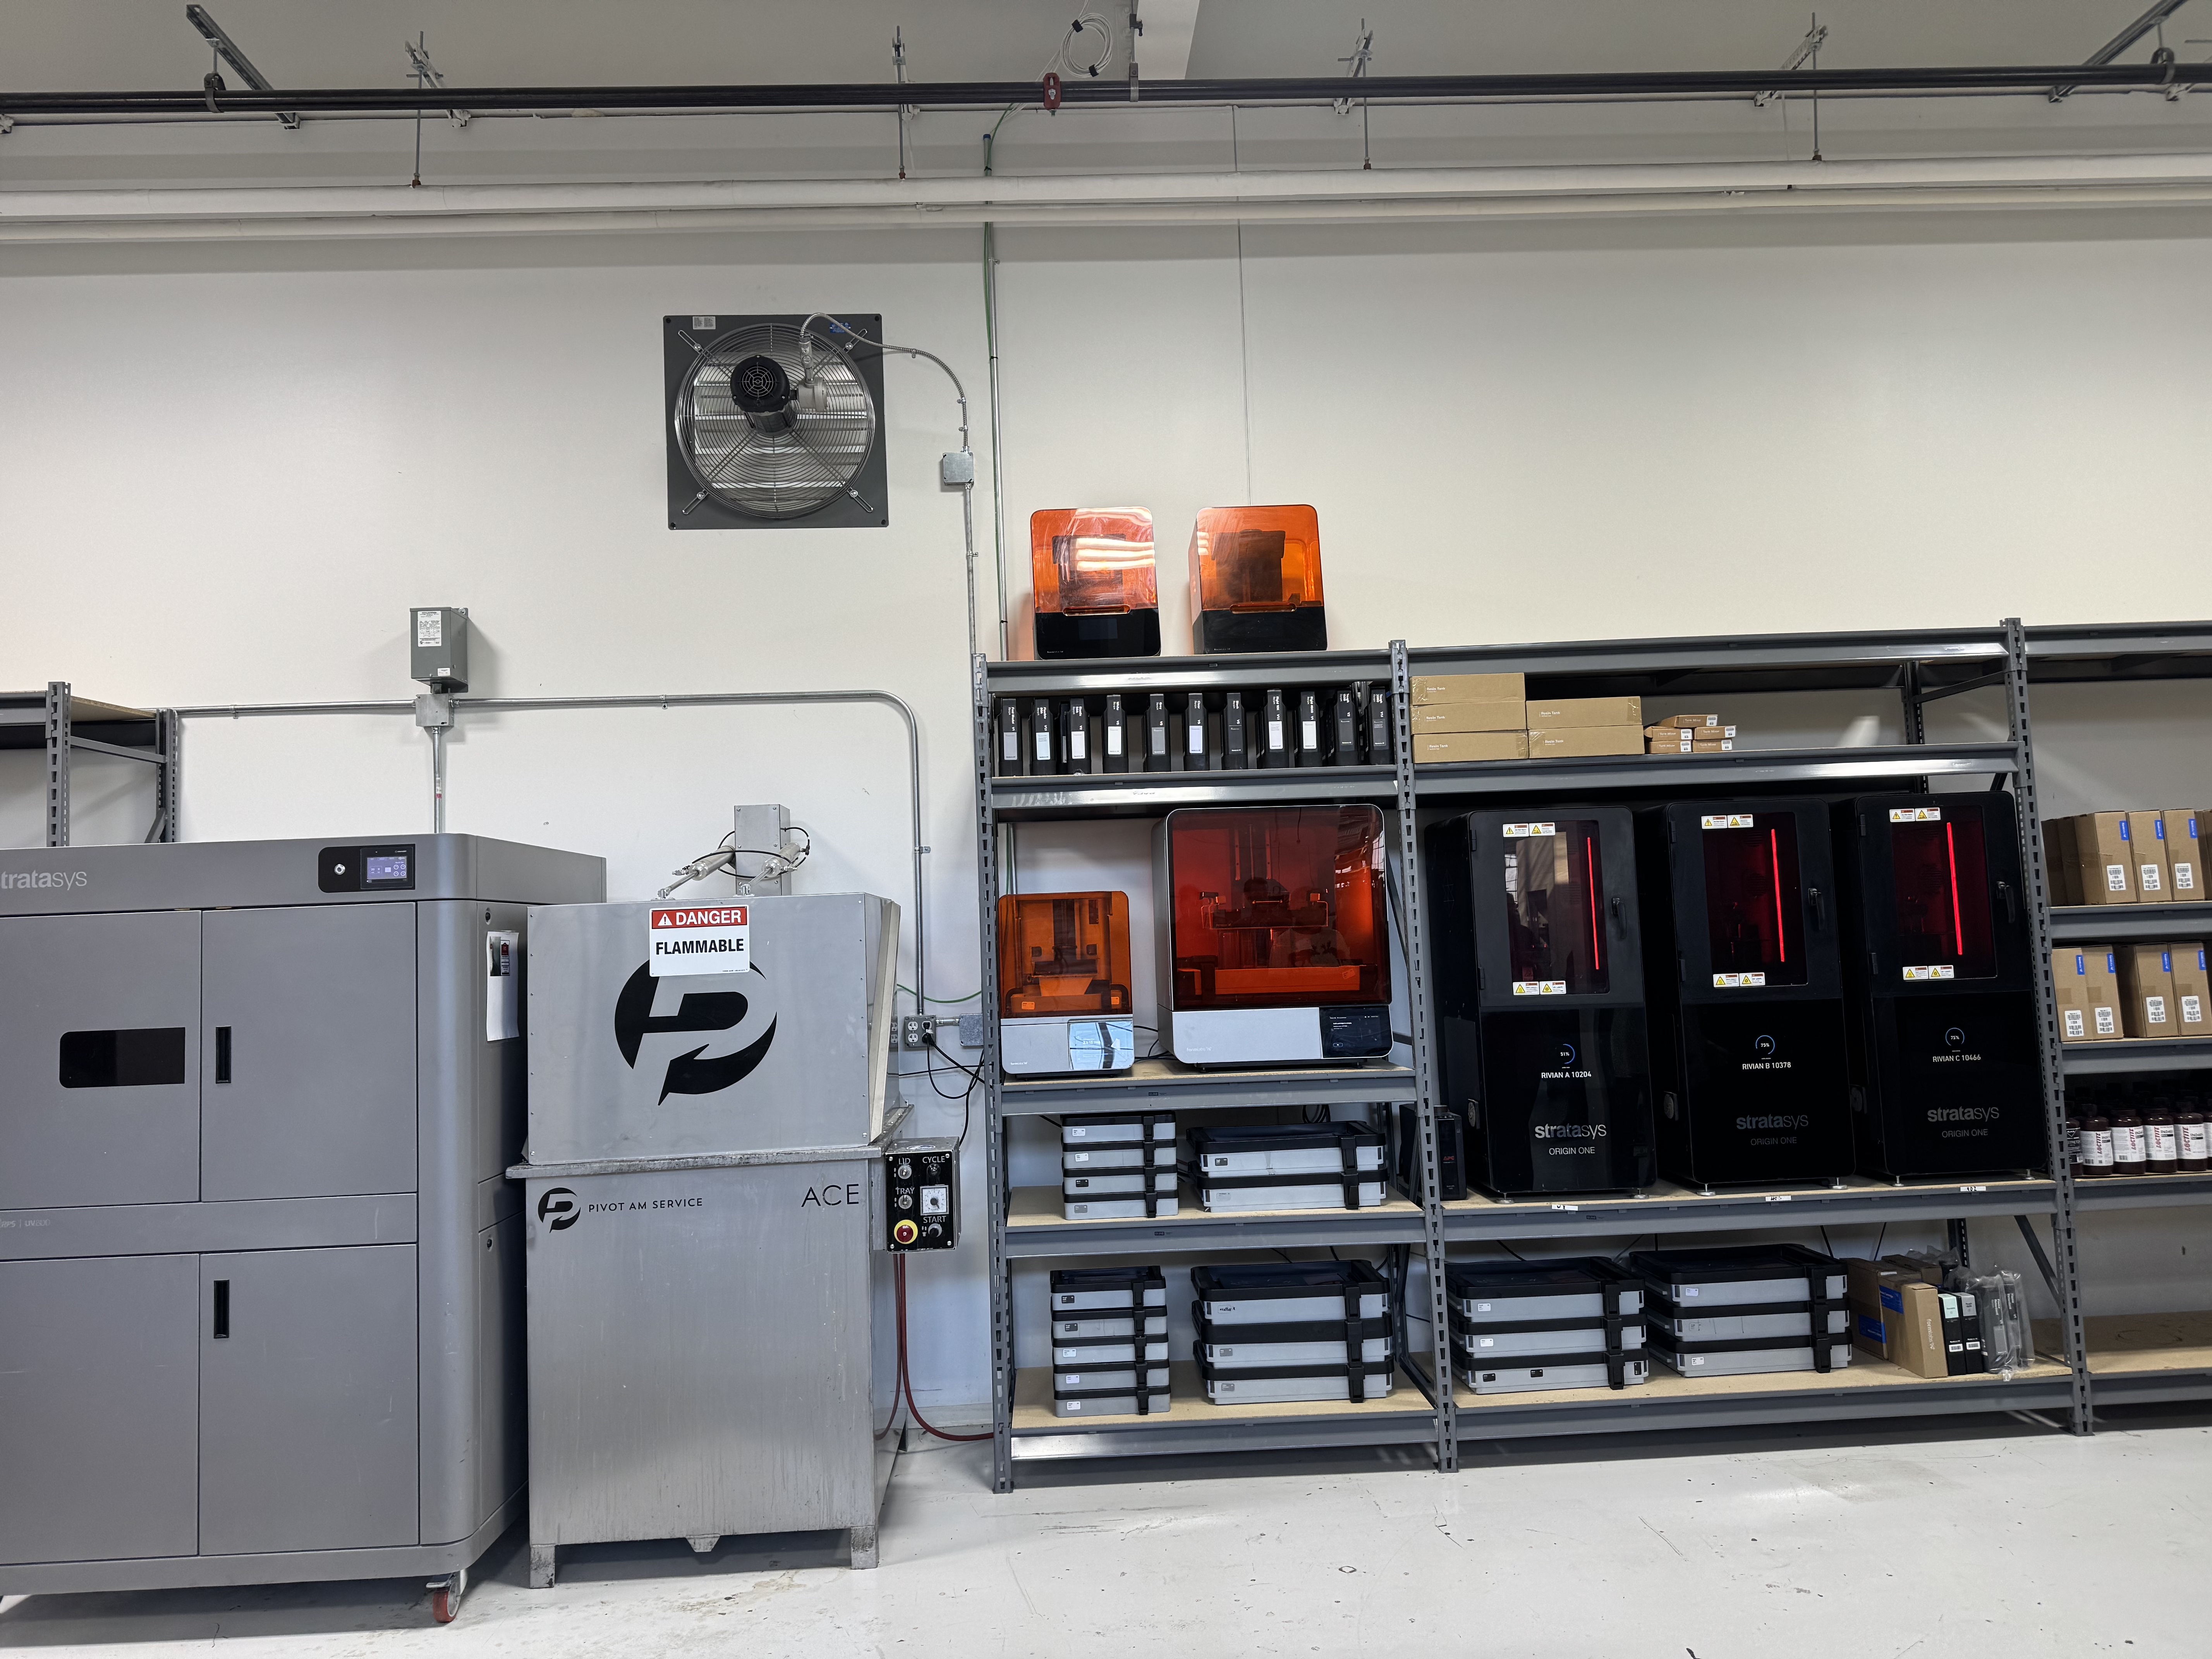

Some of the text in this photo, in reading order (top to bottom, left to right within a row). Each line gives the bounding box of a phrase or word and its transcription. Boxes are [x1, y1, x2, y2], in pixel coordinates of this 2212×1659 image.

[0, 869, 87, 891] tratasys
[676, 910, 741, 926] DANGER
[656, 939, 744, 955] FLAMMABLE
[1927, 1106, 1999, 1121] stratasys
[1736, 1114, 1808, 1130] stratasys
[1535, 1123, 1607, 1139] stratasys
[1942, 1130, 1969, 1138] ORIGIN
[1750, 1137, 1778, 1146] ORIGIN
[2182, 1127, 2191, 1152] LOCTITE
[801, 1183, 859, 1207] ACE
[895, 1187, 915, 1195] TRAY
[589, 1198, 702, 1212] PIVOT AM SERVICE
